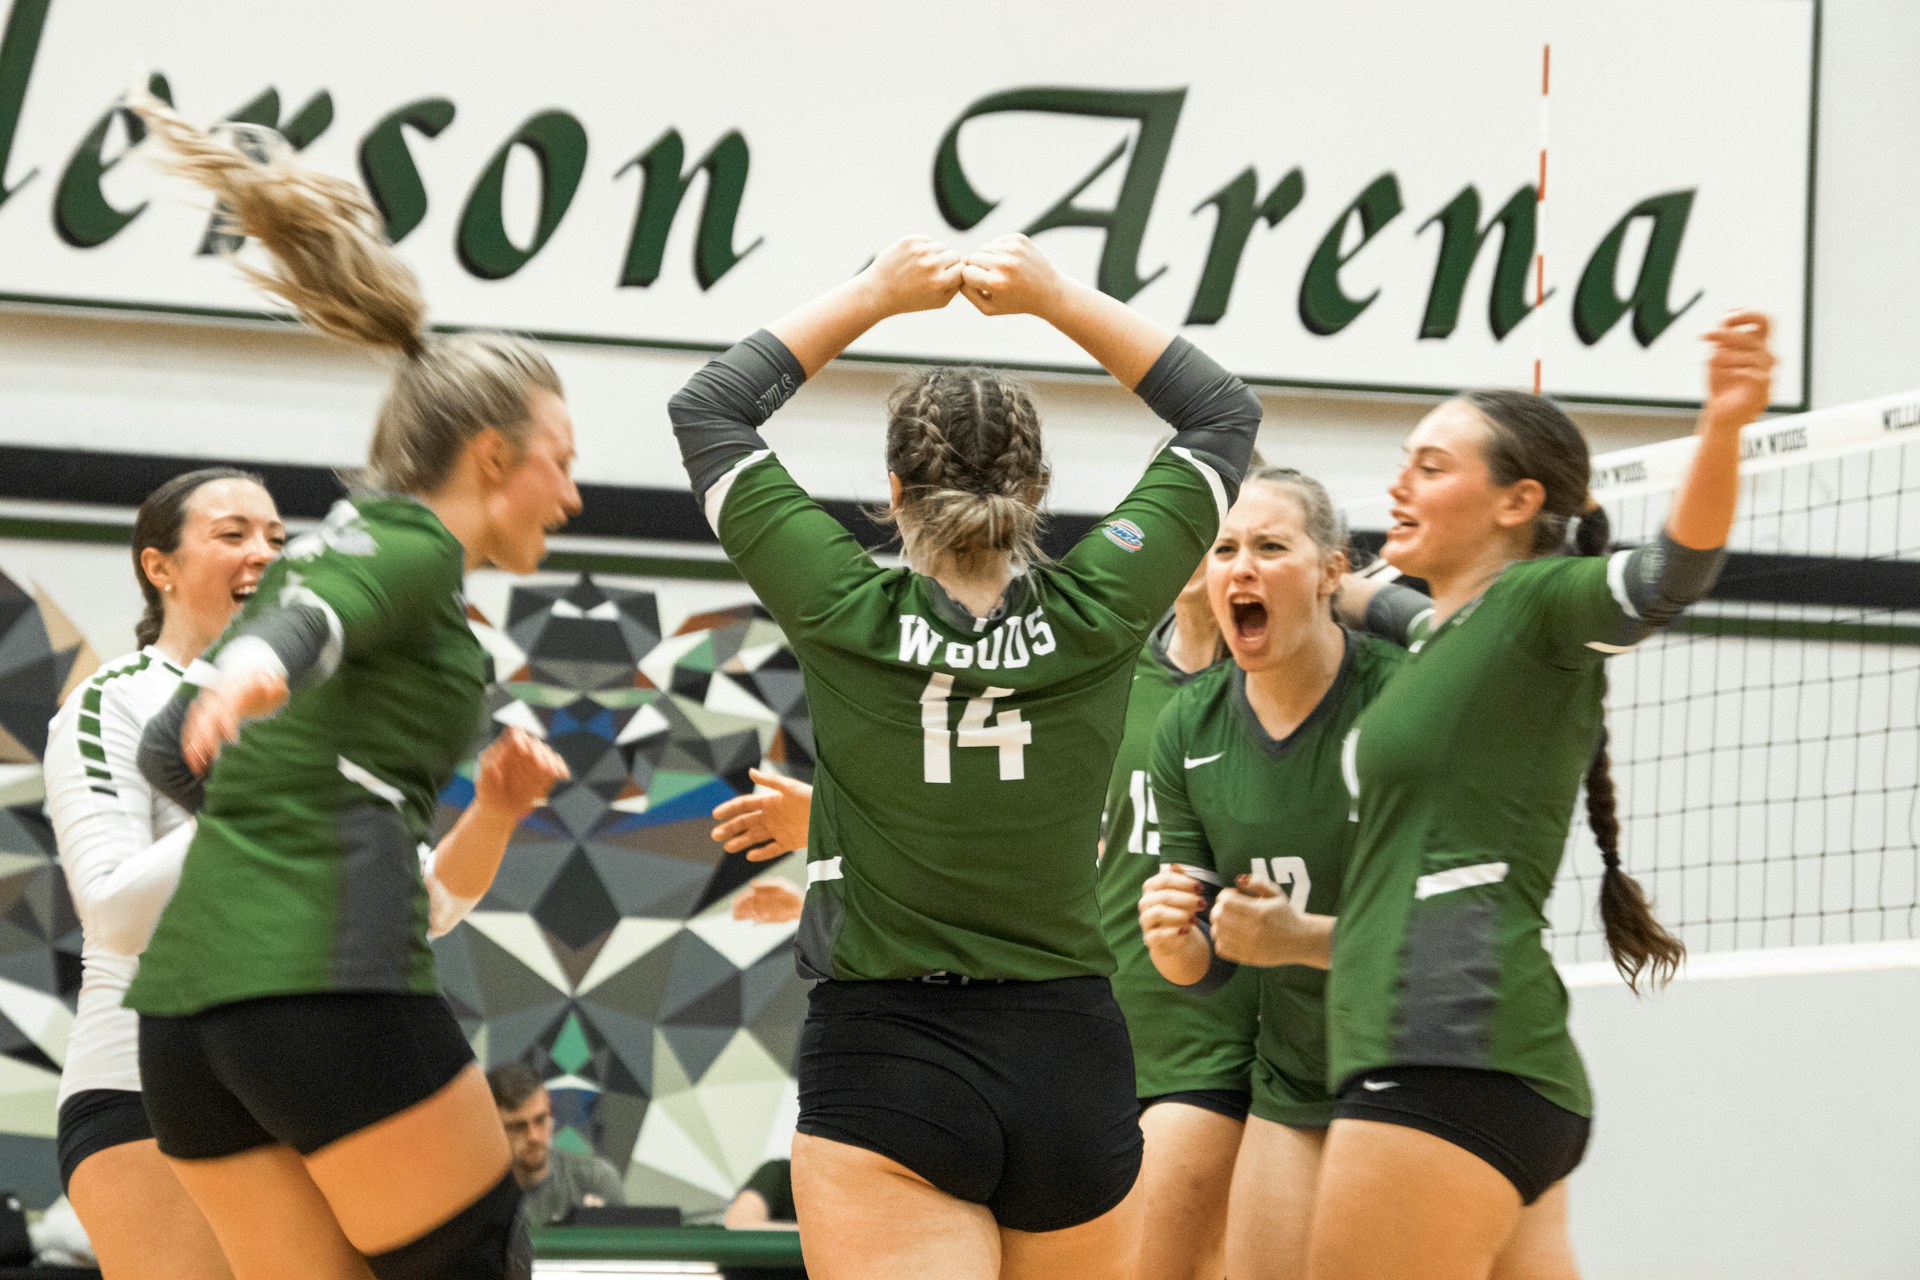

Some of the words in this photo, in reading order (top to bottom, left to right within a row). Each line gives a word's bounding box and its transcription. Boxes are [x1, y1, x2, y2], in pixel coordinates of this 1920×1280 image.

[932, 85, 1705, 349] Arena
[1767, 427, 1807, 453] WOODS
[898, 604, 1057, 671] WOODS
[919, 671, 1032, 784] 14
